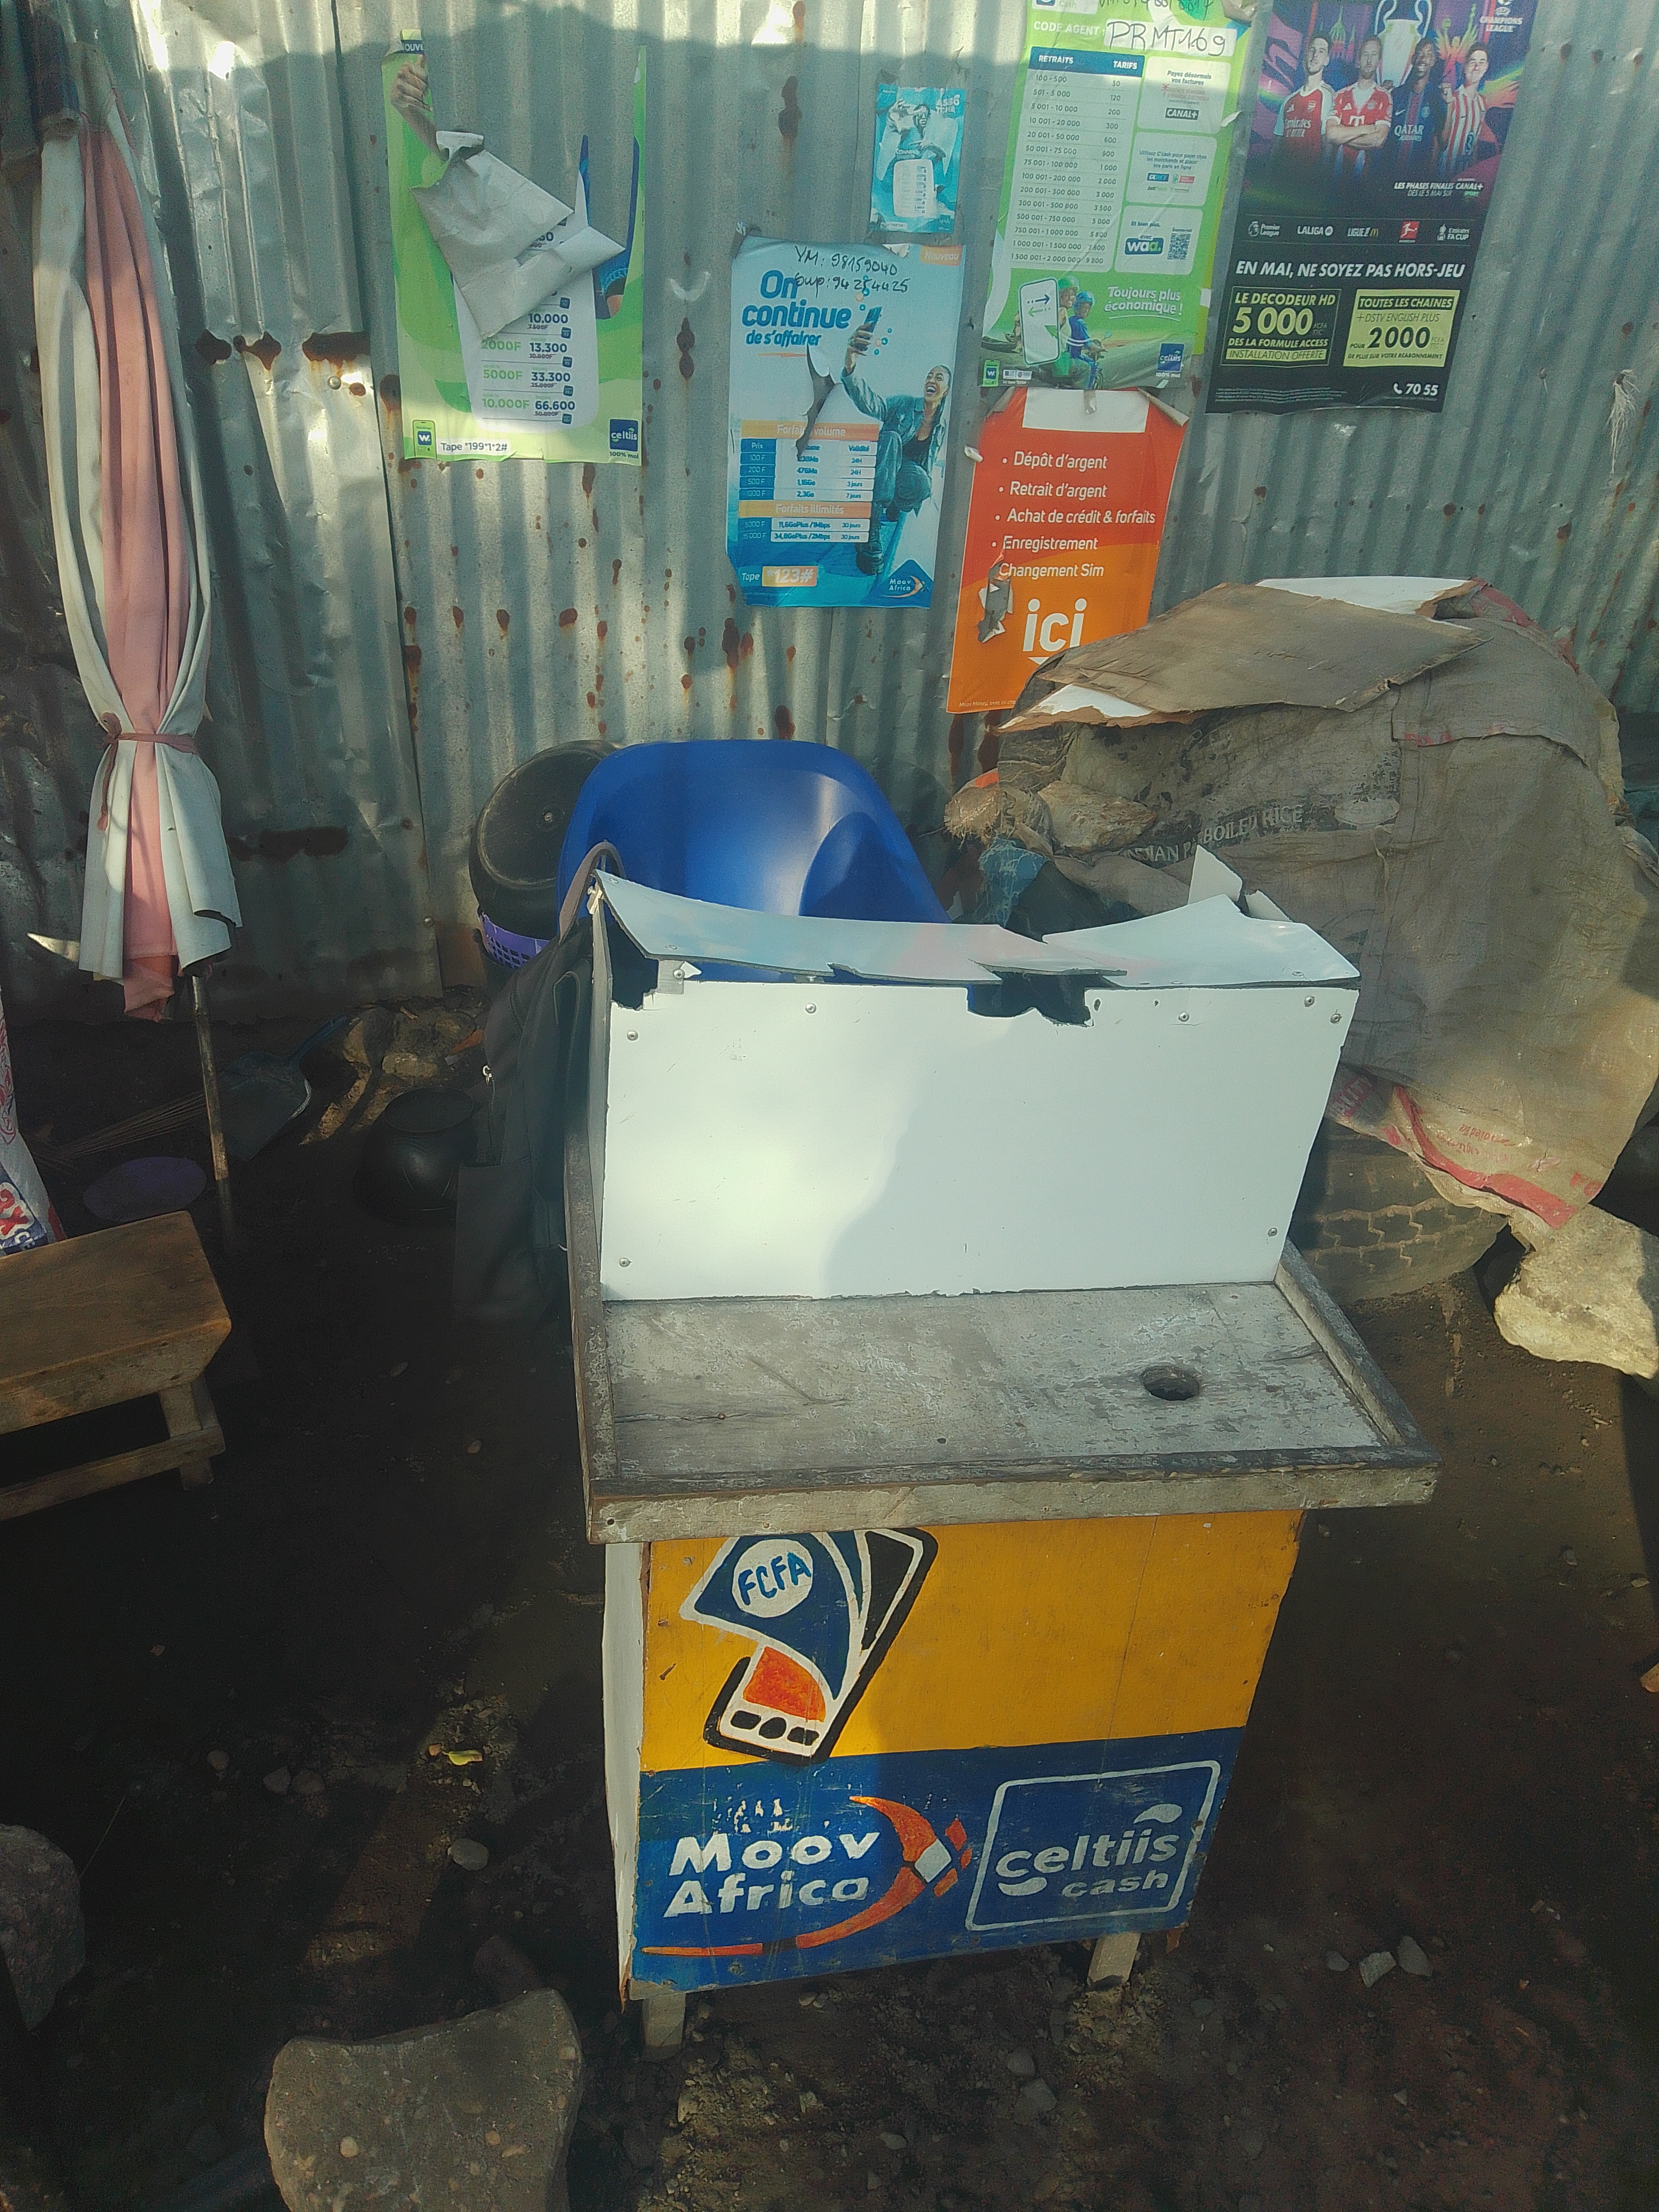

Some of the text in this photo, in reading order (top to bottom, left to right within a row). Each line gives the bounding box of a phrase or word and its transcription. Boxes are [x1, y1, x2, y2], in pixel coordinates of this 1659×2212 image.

[1034, 21, 1100, 36] CODE AGENT
[1038, 54, 1138, 70] RETRAITS TARIFS
[1167, 109, 1197, 118] CANAL+
[1394, 124, 1424, 135] QATAR
[1297, 225, 1323, 235] LALIGA
[1236, 261, 1466, 279] EN MAI, NE SOYEZ PAS HORS-JEU
[760, 270, 797, 299] On
[1108, 286, 1181, 304] Toujours plus
[1234, 292, 1336, 306] LE DECODEUR HD
[1104, 300, 1177, 315] économique
[1359, 298, 1453, 308] TOUTES LES CHAINES
[529, 313, 568, 323] 10.000
[741, 299, 852, 329] continue
[1386, 313, 1419, 322] ENGLISH
[1421, 313, 1440, 322] PLUS
[745, 330, 763, 345] de
[1228, 338, 1244, 346] DES
[1258, 339, 1300, 348] FORMULE
[1300, 339, 1329, 347] ACCESS
[481, 339, 567, 353] 2000F 13.300
[1229, 350, 1325, 359] INSTALLATION OFFERTE
[483, 370, 571, 382] 5000F 33.300
[1405, 383, 1438, 396] 70 55
[482, 398, 575, 410] 10.000F 66.600
[611, 431, 637, 440] celtiis
[814, 426, 846, 437] volume
[440, 442, 462, 453] Tape
[1013, 450, 1108, 472] Dépôt d'argent
[1010, 481, 1107, 501] Retrait d'argent
[776, 504, 844, 514] Forfaits illimités
[1007, 508, 1156, 524] Achat de crédit & forfaits
[1002, 535, 1098, 552] Enregistrement
[741, 572, 760, 582] Tape
[999, 563, 1104, 580] Changement Sim
[1022, 598, 1087, 652] ici
[1262, 804, 1305, 827] RICE
[738, 1551, 811, 1605] FCFA
[668, 1829, 882, 1878] Moov
[995, 1828, 1180, 1878] celtiis
[1062, 1870, 1169, 1897] cash
[662, 1871, 870, 1917] Africa
